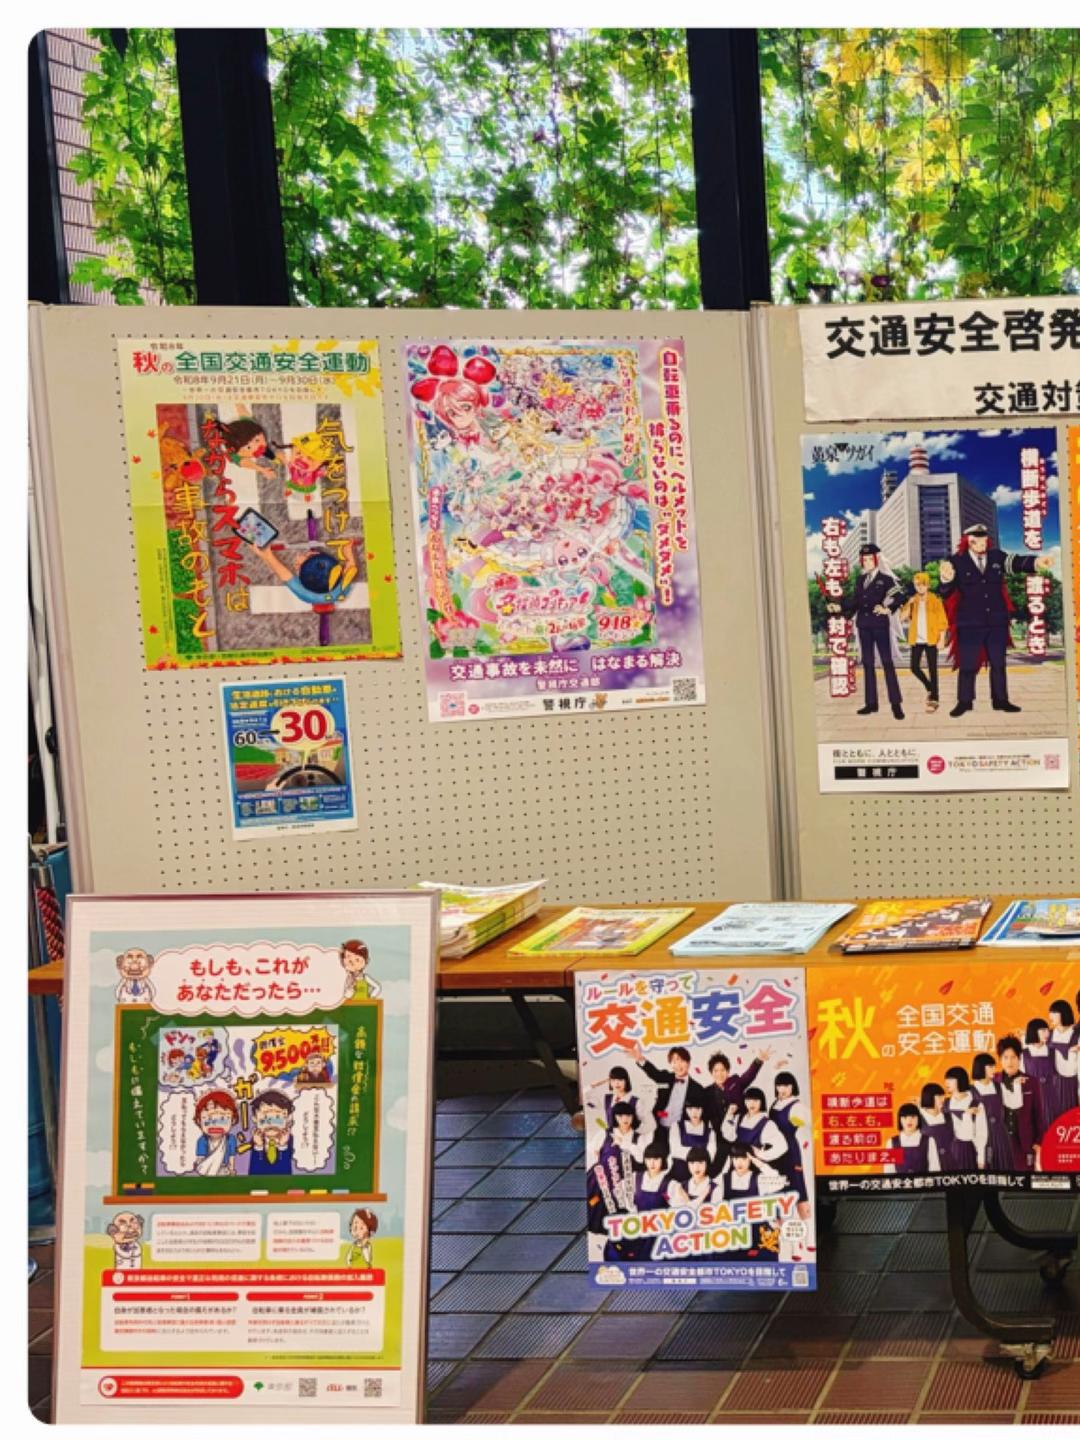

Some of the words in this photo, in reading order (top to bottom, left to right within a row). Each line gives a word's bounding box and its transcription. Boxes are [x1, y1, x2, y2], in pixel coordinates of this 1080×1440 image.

[132, 350, 371, 376] 秋の全国交通安全運動
[317, 415, 354, 562] 気をつけて
[234, 731, 257, 746] 60
[280, 709, 328, 743] 30
[190, 956, 310, 978] もしも、これが
[586, 975, 694, 1002] ルールを守って
[588, 984, 794, 1053] 交通安全
[896, 1001, 996, 1028] 全国交通
[817, 997, 896, 1061] 秋の
[897, 1030, 996, 1057] 安全運動
[608, 1209, 694, 1238] TOKYO
[699, 1196, 796, 1225] SAFETY
[655, 1227, 749, 1256] ACTION
